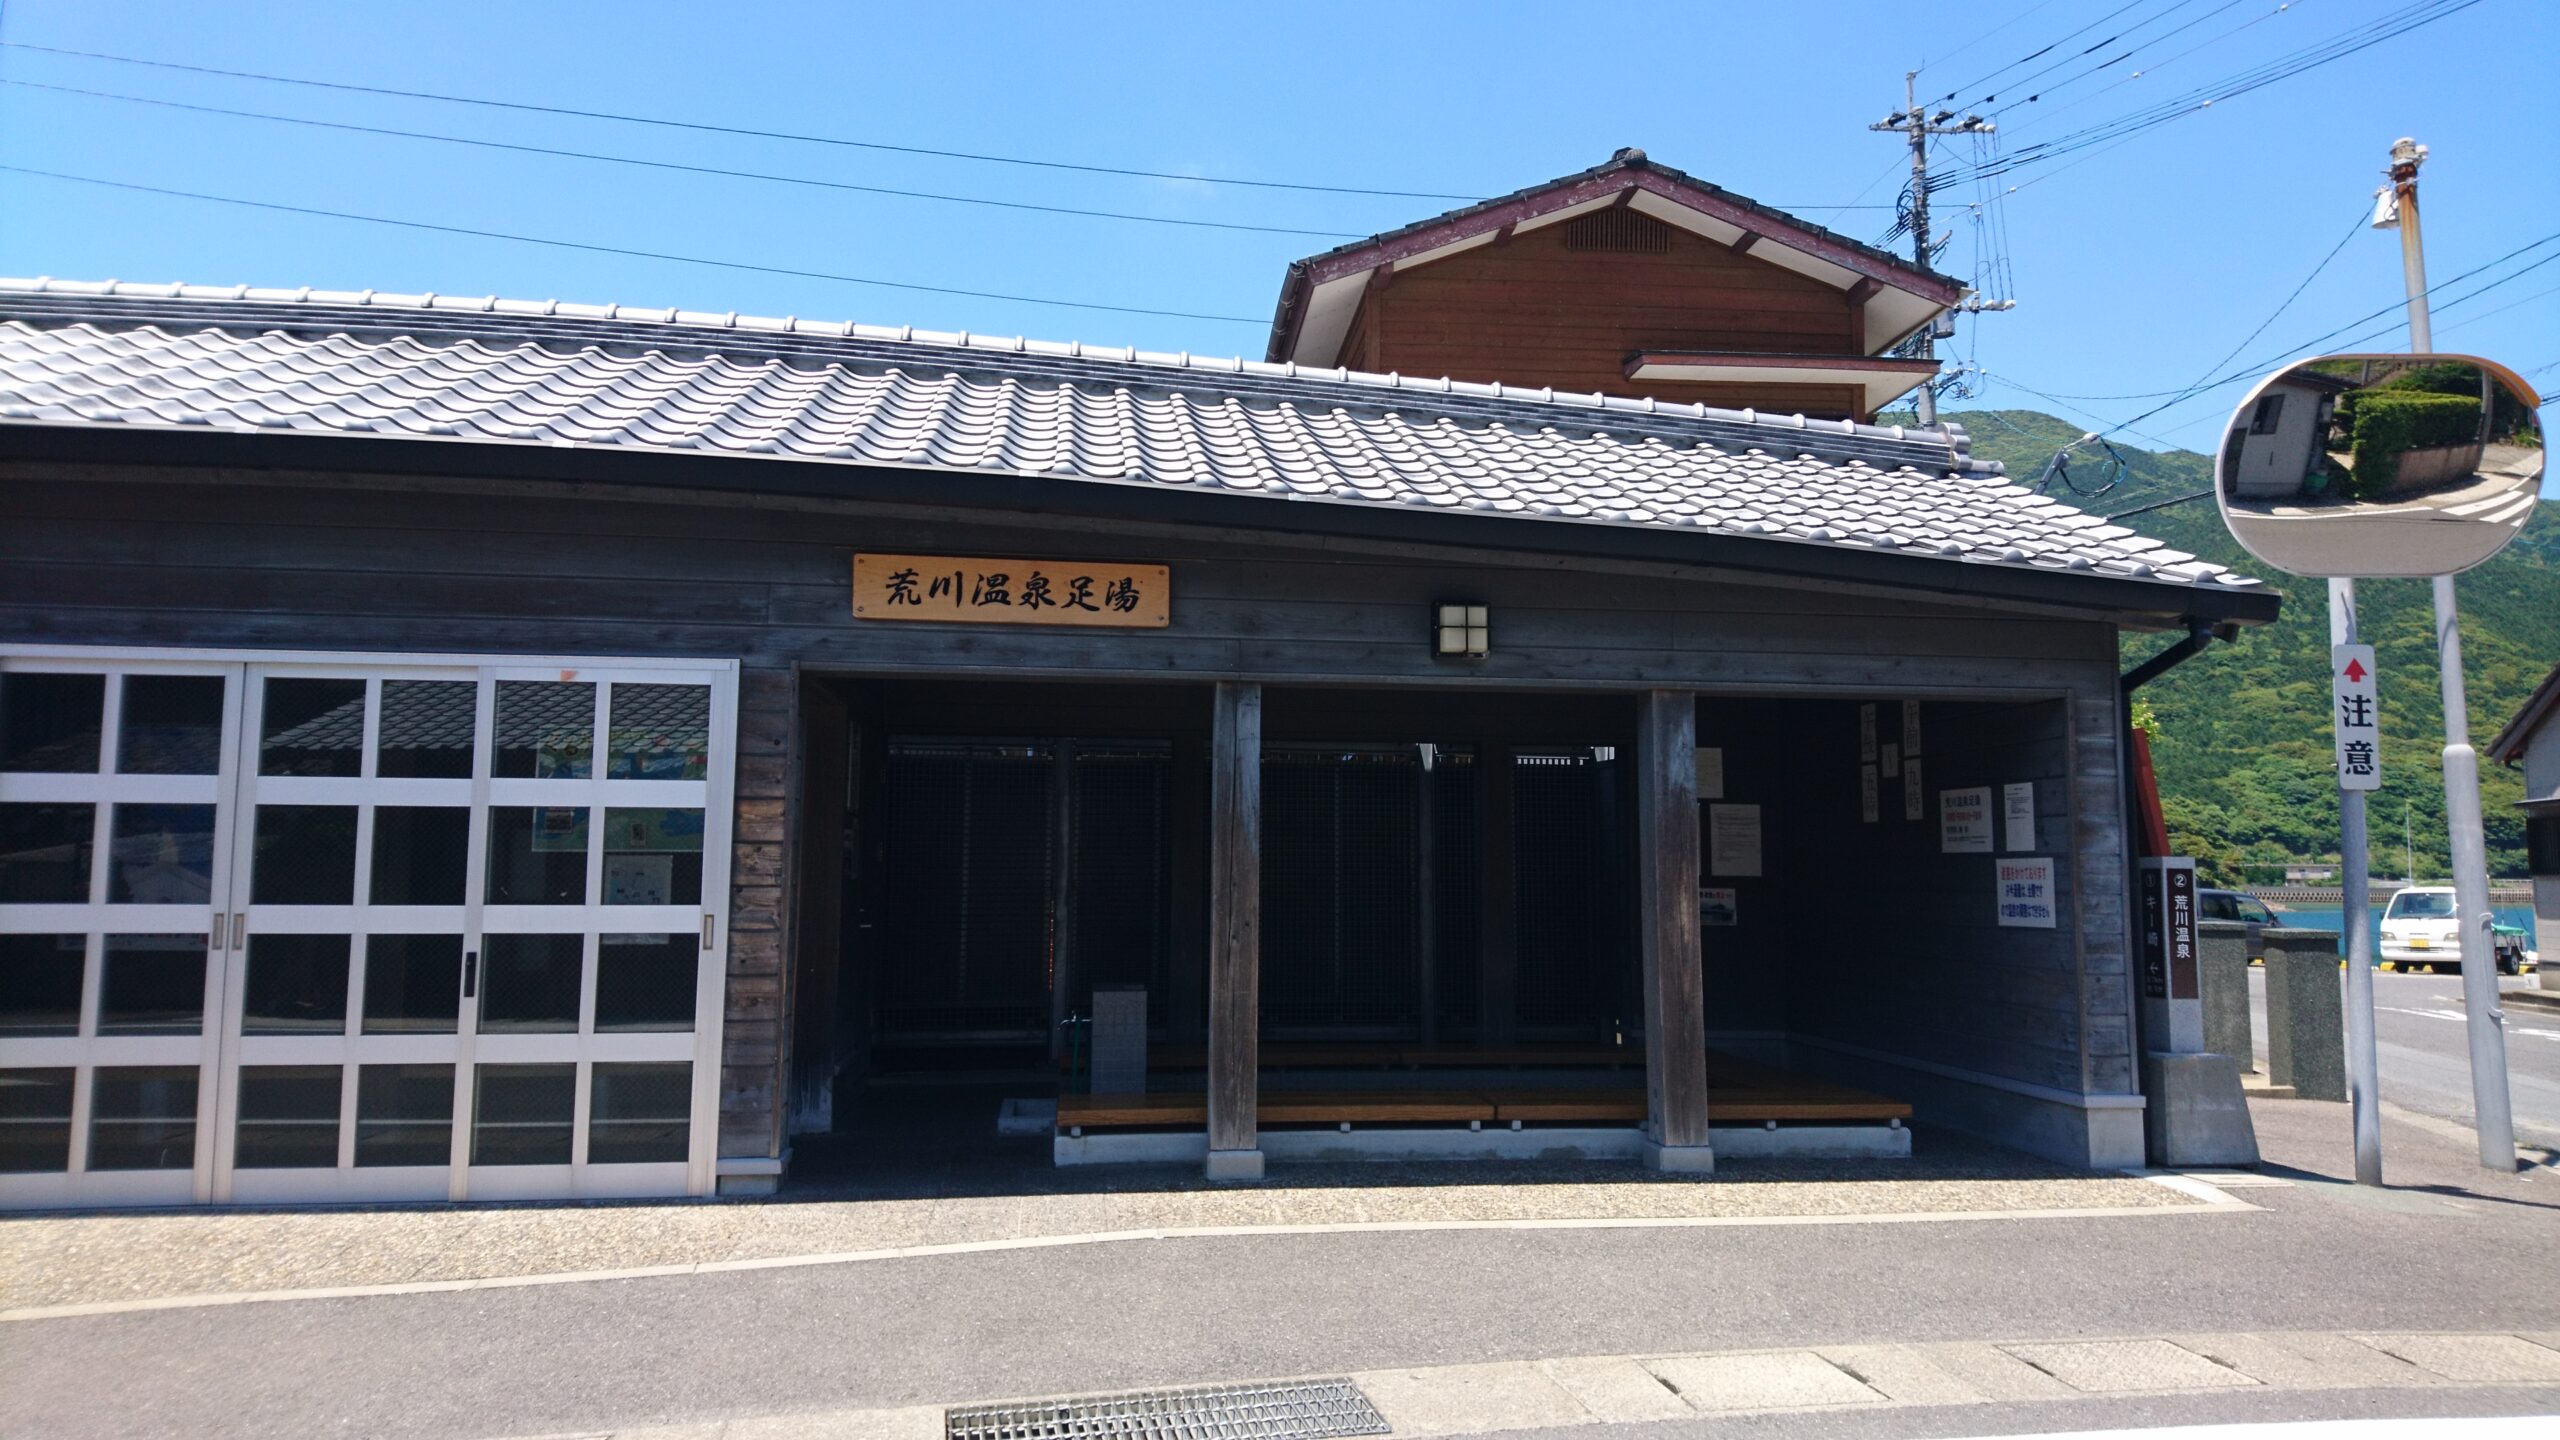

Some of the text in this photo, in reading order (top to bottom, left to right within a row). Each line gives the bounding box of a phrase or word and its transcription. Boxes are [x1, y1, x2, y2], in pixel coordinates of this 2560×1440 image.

[885, 567, 1141, 613] 荒川温泉足湯
[2341, 695, 2374, 775] 注意
[2174, 895, 2190, 958] 荒川温泉
